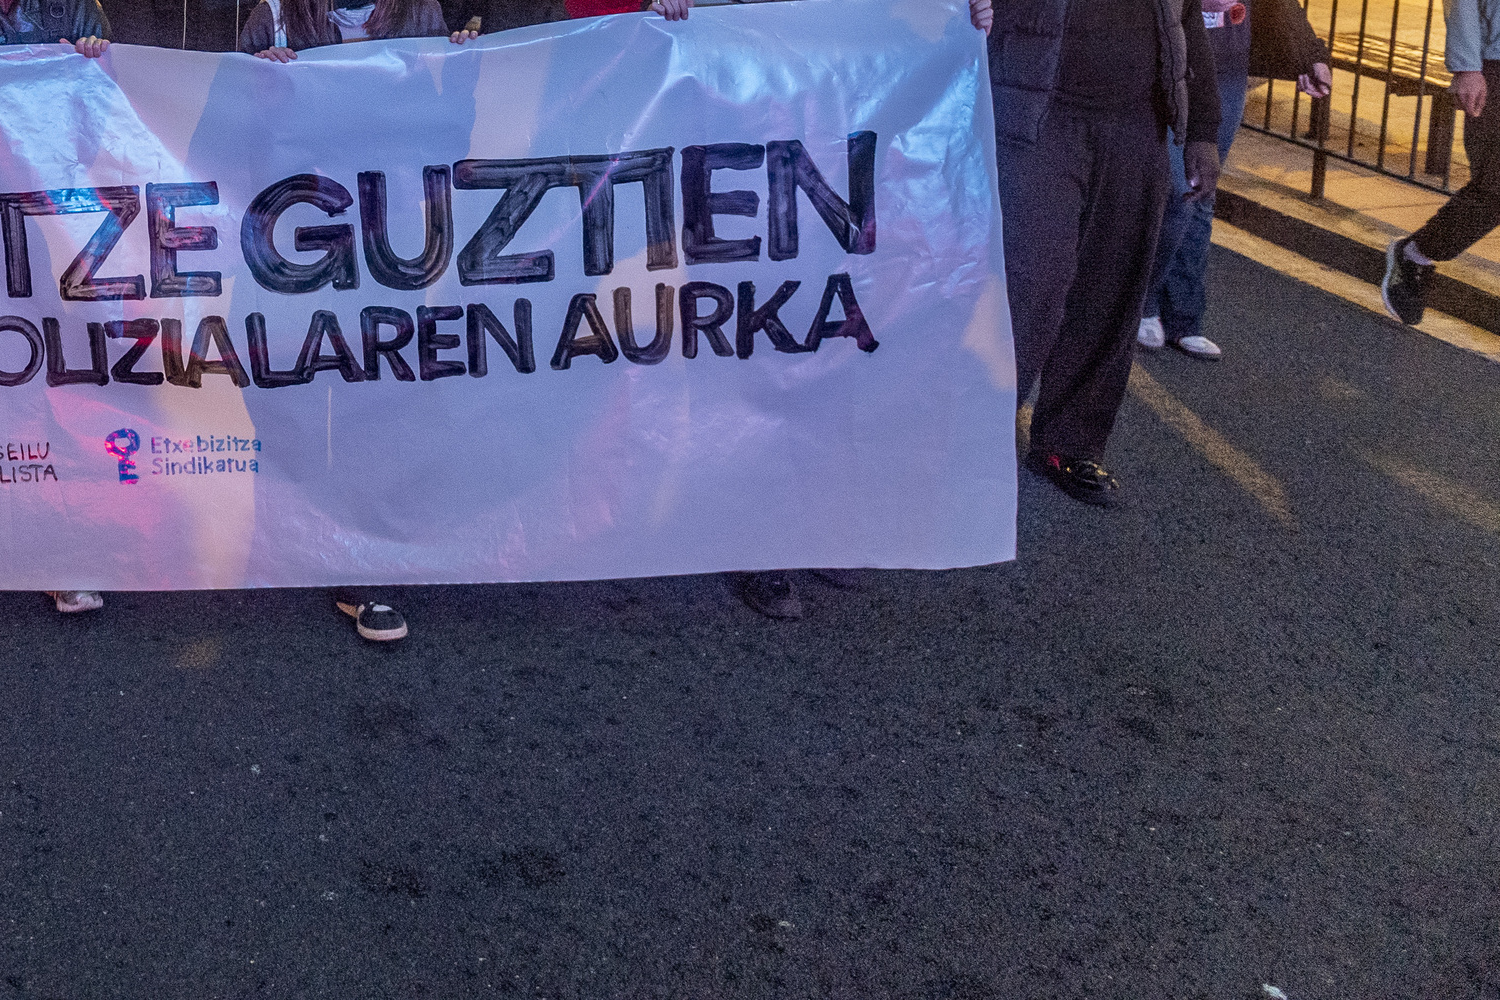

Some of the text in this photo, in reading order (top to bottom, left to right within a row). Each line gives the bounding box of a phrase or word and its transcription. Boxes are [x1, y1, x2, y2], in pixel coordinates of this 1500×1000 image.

[240, 130, 878, 293] GUZTIEN
[550, 272, 879, 371] AURKA
[150, 435, 262, 455] Etxebizitza
[151, 455, 260, 476] Sindikatua
